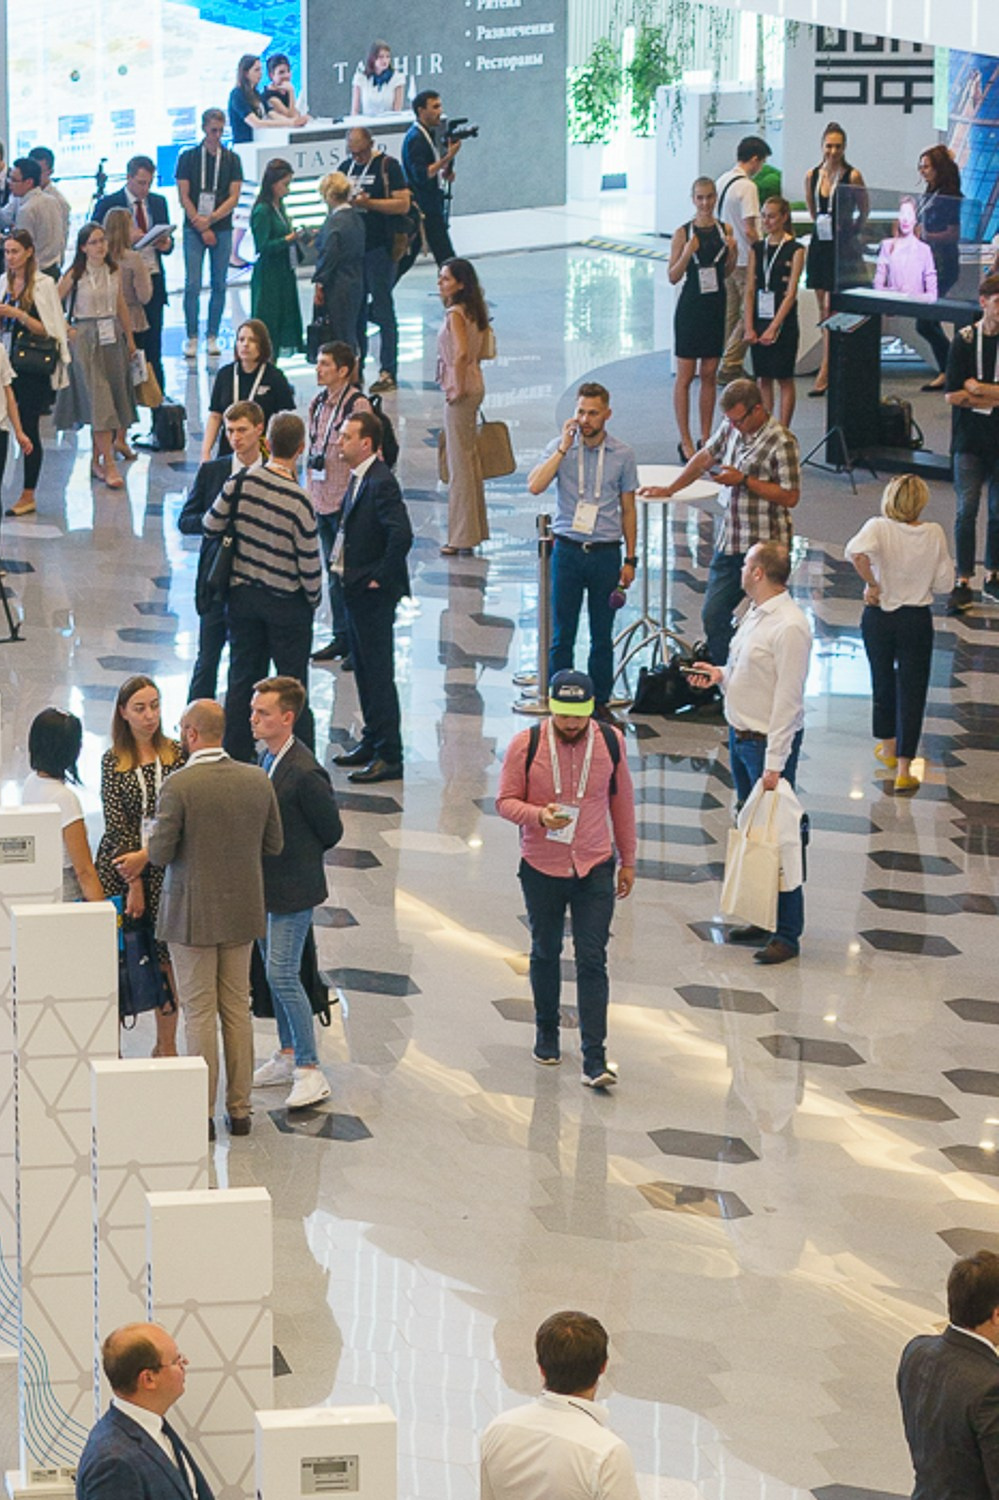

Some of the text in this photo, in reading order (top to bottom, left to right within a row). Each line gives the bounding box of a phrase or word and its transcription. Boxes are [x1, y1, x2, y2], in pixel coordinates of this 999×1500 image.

[476, 23, 555, 41] Развлечения
[332, 53, 443, 84] TAHIR
[476, 53, 544, 71] Рестораны
